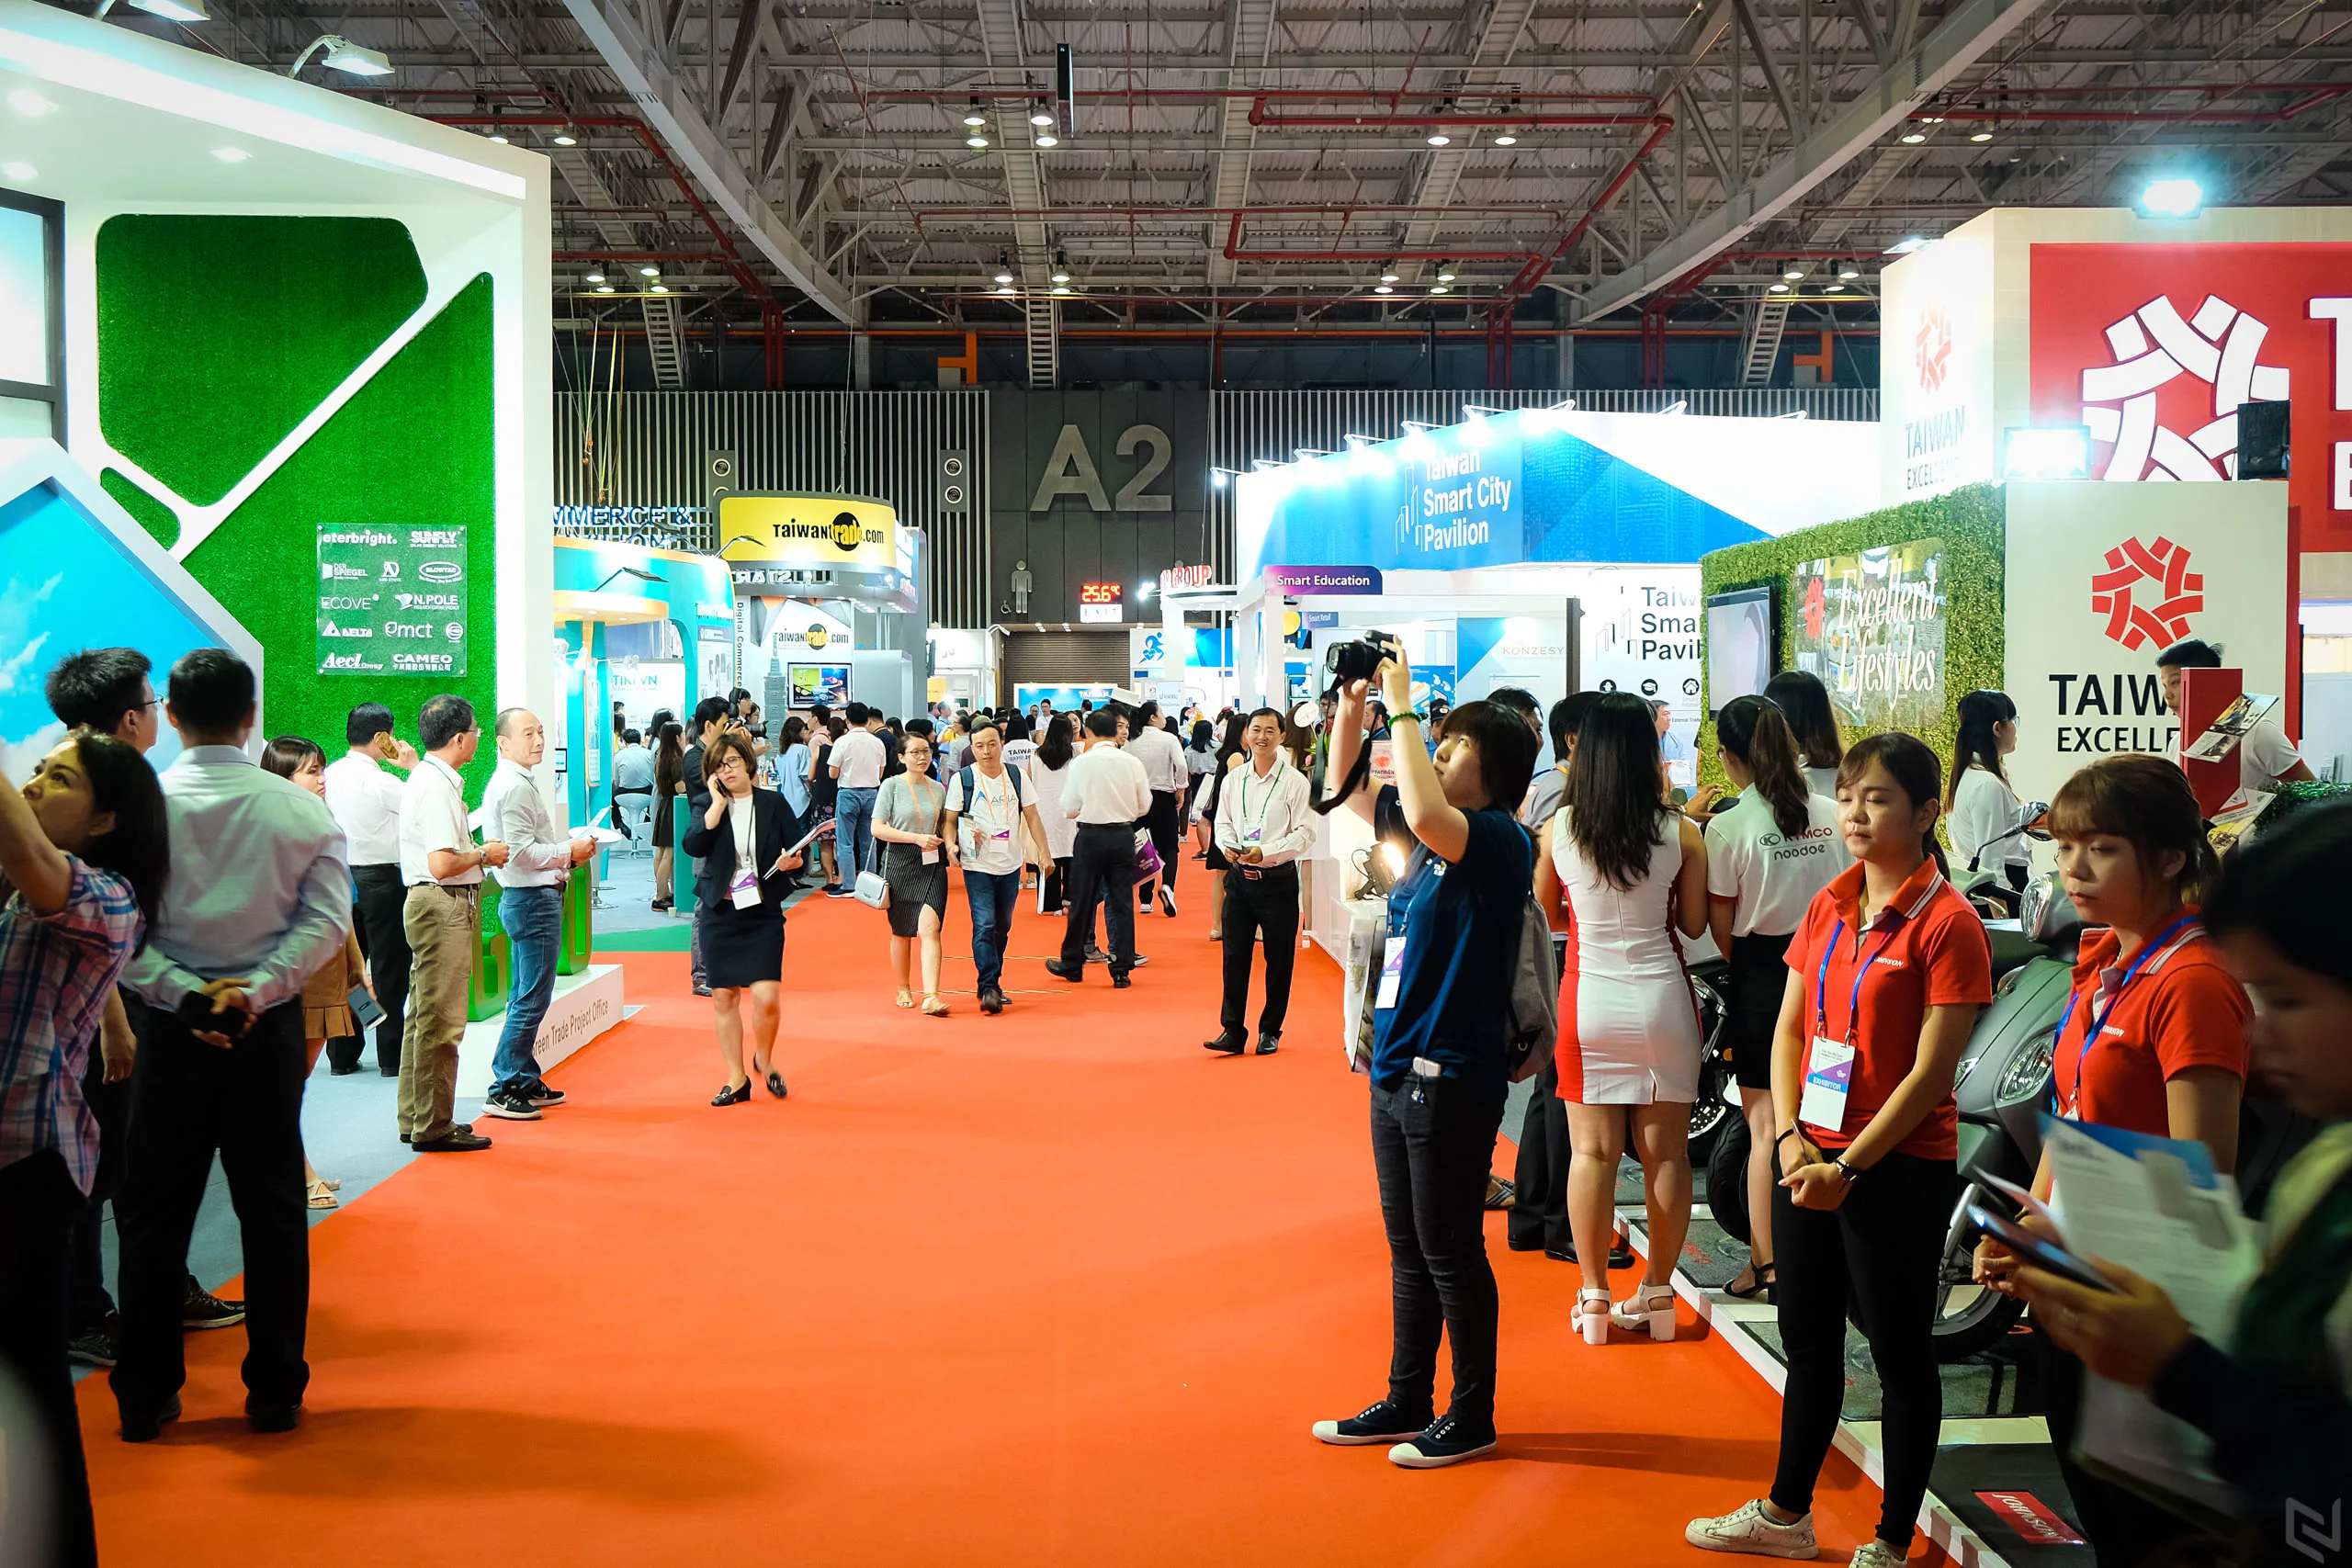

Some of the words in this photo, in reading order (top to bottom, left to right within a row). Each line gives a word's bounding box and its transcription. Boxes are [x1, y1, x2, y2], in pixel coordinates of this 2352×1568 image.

[1905, 405, 1964, 459] TAIWAN
[1030, 424, 1171, 512] A2
[1426, 449, 1481, 482] Taiwan
[1423, 481, 1474, 517] Smart
[1476, 475, 1512, 512] City
[674, 505, 693, 526] &
[1424, 516, 1489, 552] Pavilion
[334, 569, 368, 577] SPIEGEL
[1172, 564, 1212, 589] GROUP
[1277, 575, 1311, 586] Smart
[1314, 574, 1370, 586] Education
[322, 596, 372, 610] ECOVE
[414, 594, 458, 605] N.POLE
[1838, 557, 1939, 629] Excellent
[735, 602, 744, 633] Digital
[1308, 614, 1319, 623] Smart
[1641, 613, 1697, 634] Sma
[342, 627, 373, 637] DELTA
[392, 653, 453, 663] CAMEO
[736, 636, 744, 687] Commerce
[1502, 646, 1564, 656] KONZESY
[1837, 625, 1936, 710] Lifestyles
[1773, 842, 1826, 861] noodoe
[551, 1023, 570, 1046] Trade
[570, 1010, 592, 1035] Project
[593, 998, 608, 1022] Office
[1813, 1077, 1842, 1091] EXHIBITOR
